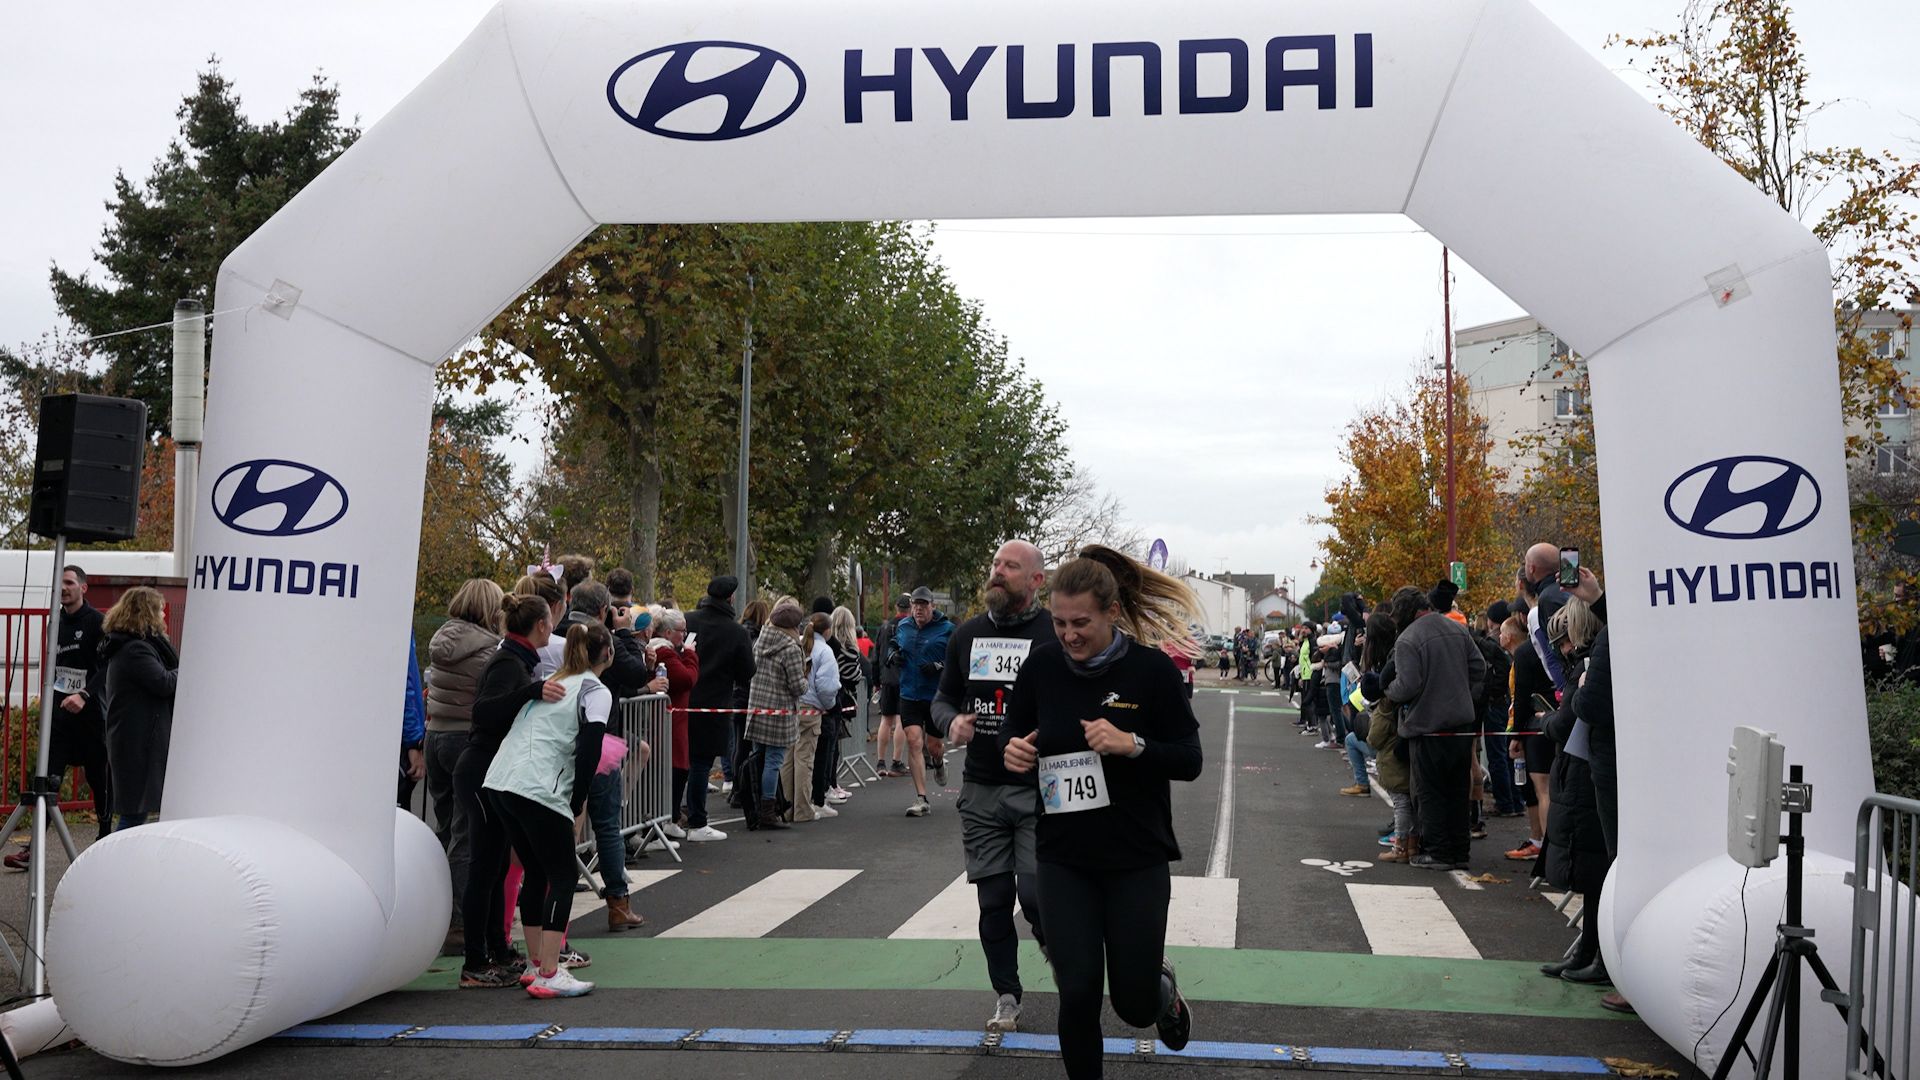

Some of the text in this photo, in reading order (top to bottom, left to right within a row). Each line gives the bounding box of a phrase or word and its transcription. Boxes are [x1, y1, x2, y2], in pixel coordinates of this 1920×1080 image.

[843, 32, 1375, 125] HYUNDAI
[193, 554, 359, 599] HYUNDAI
[1648, 561, 1841, 607] HYUNDAI
[995, 655, 1021, 674] 343
[67, 678, 82, 690] 740
[1040, 762, 1048, 772] LA
[1048, 757, 1093, 770] MARLIENNE
[1064, 775, 1097, 802] 749
